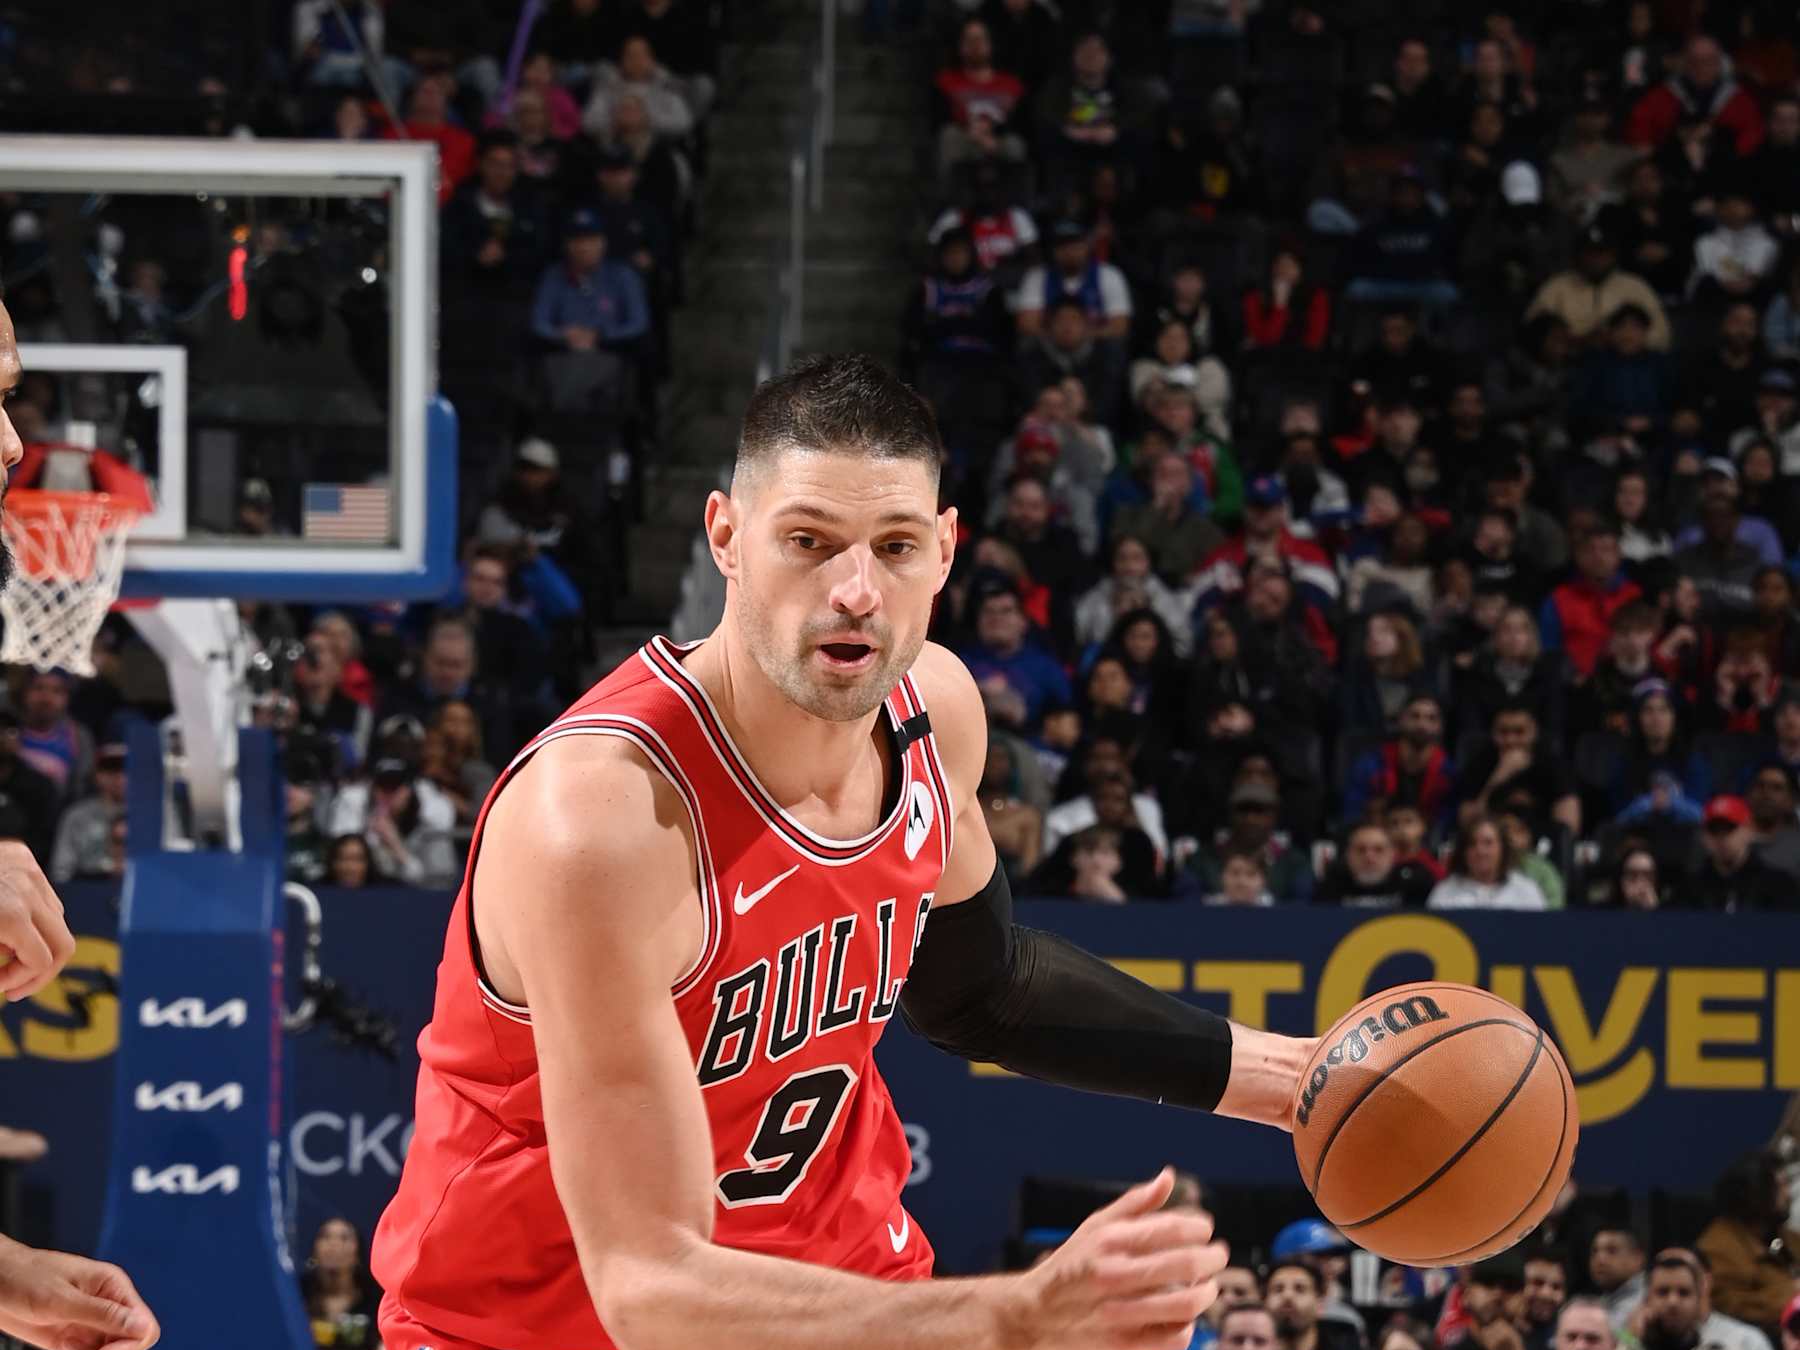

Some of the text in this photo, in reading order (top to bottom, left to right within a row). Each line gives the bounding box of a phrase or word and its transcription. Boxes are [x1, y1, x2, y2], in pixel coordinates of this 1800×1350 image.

[139, 998, 247, 1028] KIA
[1296, 995, 1450, 1128] Wilson
[135, 1081, 244, 1111] KIA
[290, 1110, 417, 1177] CK
[714, 1063, 859, 1210] 9
[131, 1164, 240, 1194] KIA
